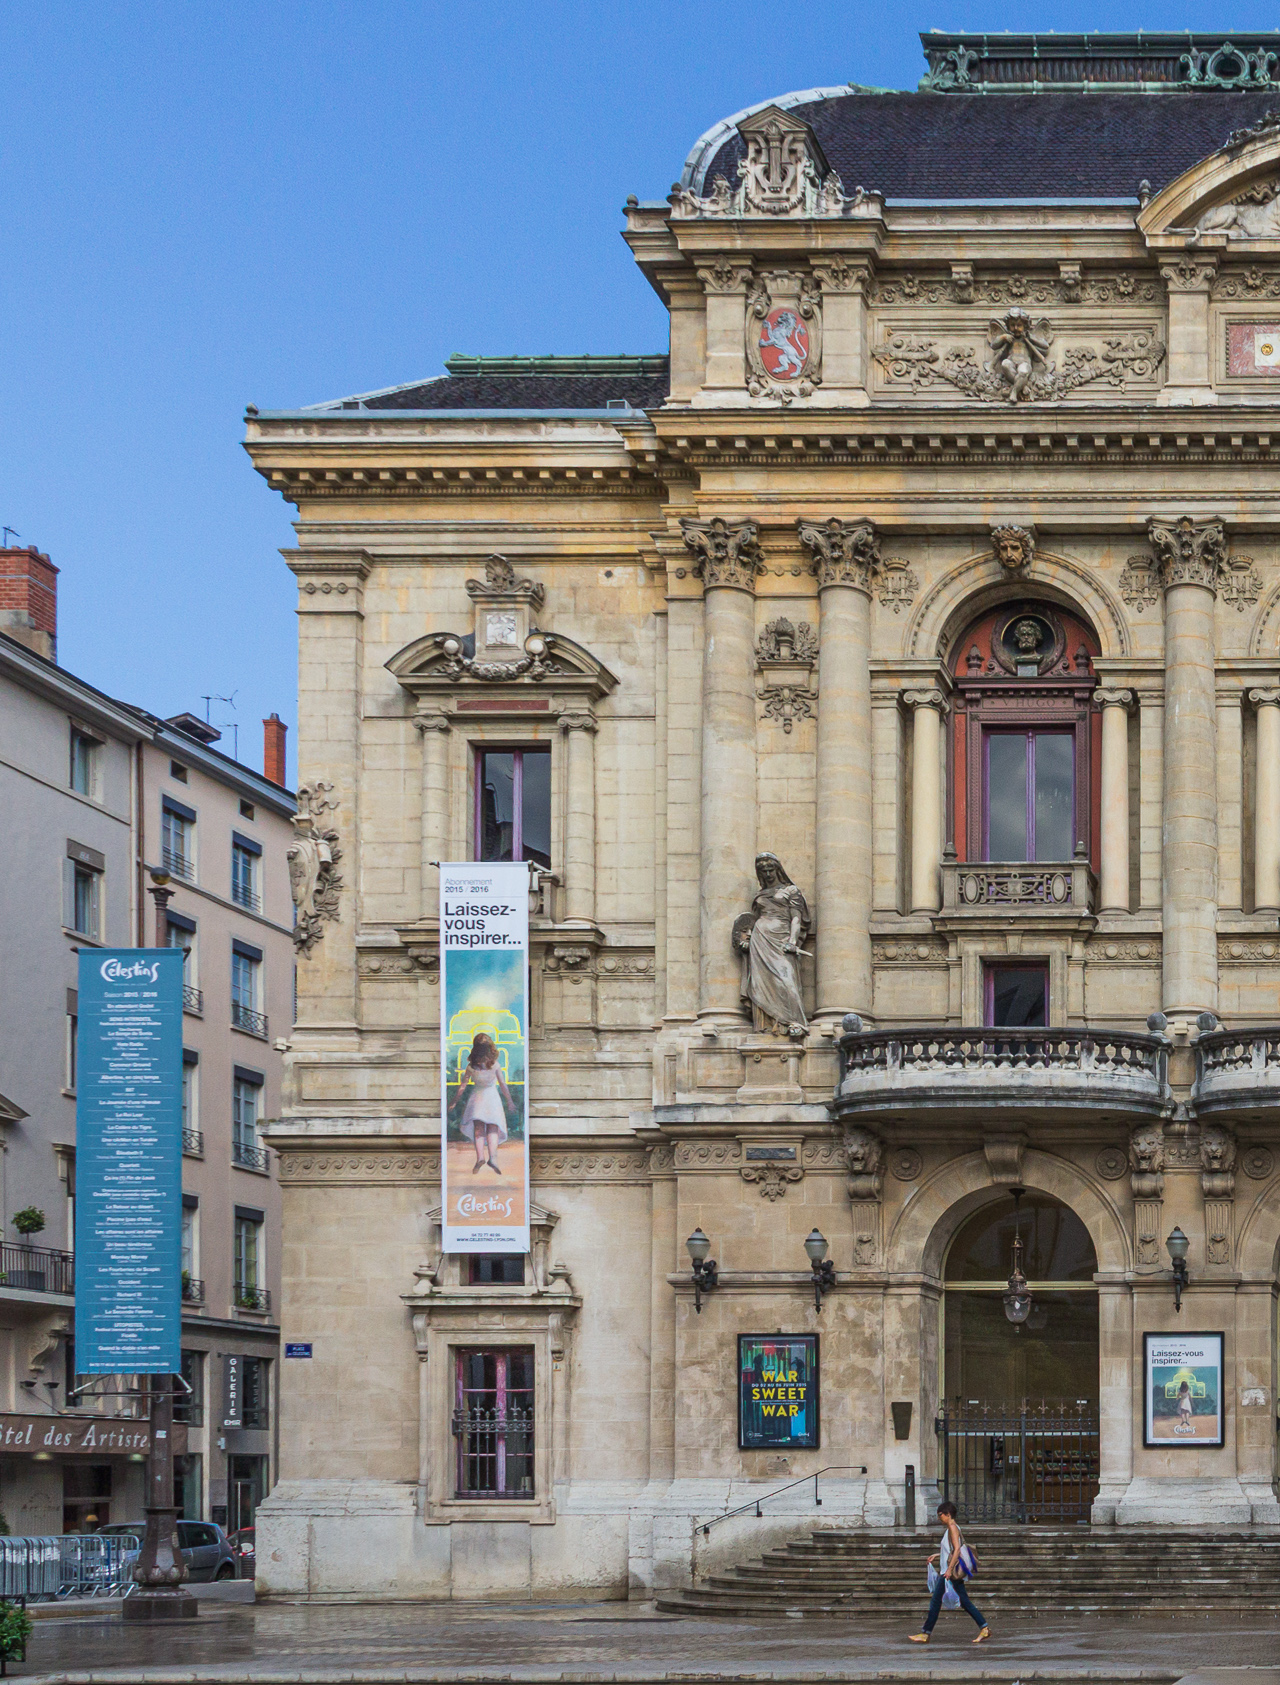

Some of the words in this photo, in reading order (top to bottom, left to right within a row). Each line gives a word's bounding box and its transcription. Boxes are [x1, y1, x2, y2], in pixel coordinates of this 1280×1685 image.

[1016, 698, 1056, 707] HUGO
[445, 878, 493, 886] Abonnement
[445, 902, 516, 916] Laissez-
[444, 919, 486, 930] vous
[445, 931, 521, 948] inspirer...
[100, 958, 161, 983] Célestins
[457, 1193, 513, 1218] Célestins
[1152, 1357, 1188, 1365] inspirer...
[762, 1371, 798, 1382] WAR
[229, 1358, 237, 1415] GALERIE
[752, 1388, 806, 1399] SWEET
[762, 1405, 799, 1416] WAR
[0, 1424, 33, 1445] tel
[44, 1425, 72, 1446] des
[81, 1424, 150, 1448] Artiste
